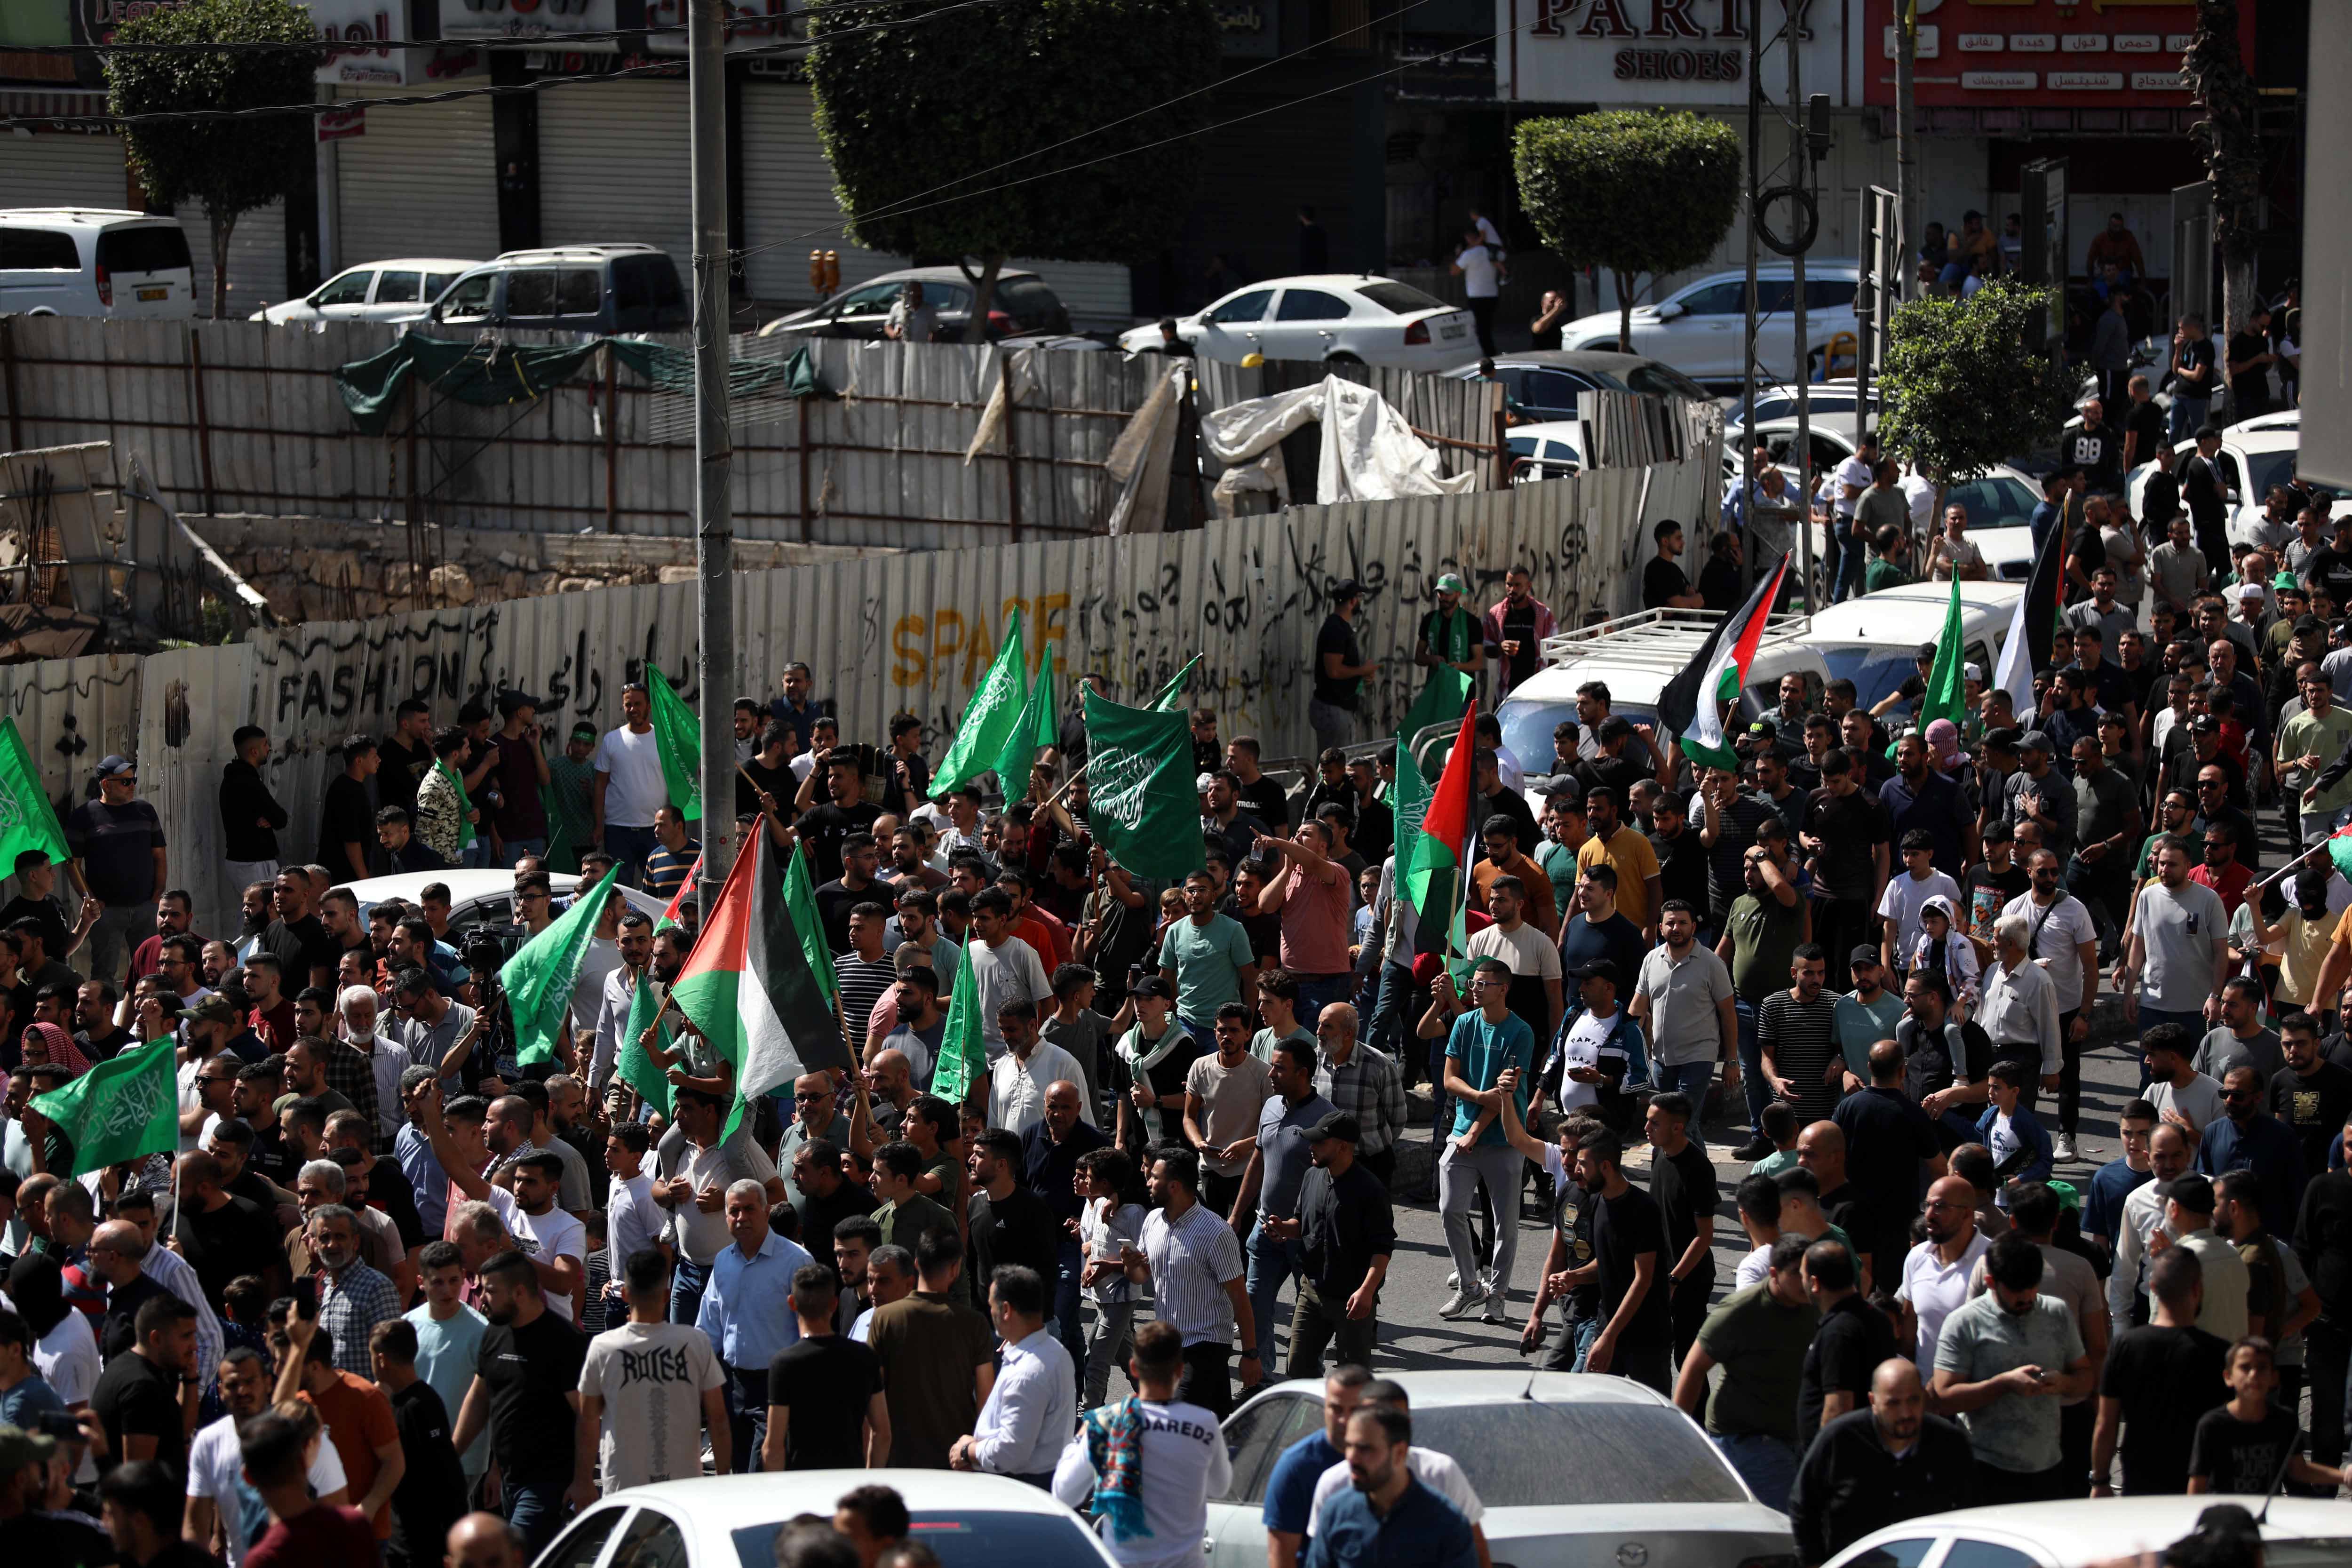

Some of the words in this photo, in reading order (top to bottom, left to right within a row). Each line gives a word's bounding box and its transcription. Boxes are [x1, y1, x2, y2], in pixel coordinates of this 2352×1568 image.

[1613, 48, 1742, 81] SHOES
[2074, 436, 2102, 460] 88
[1974, 886, 1996, 896] adidas
